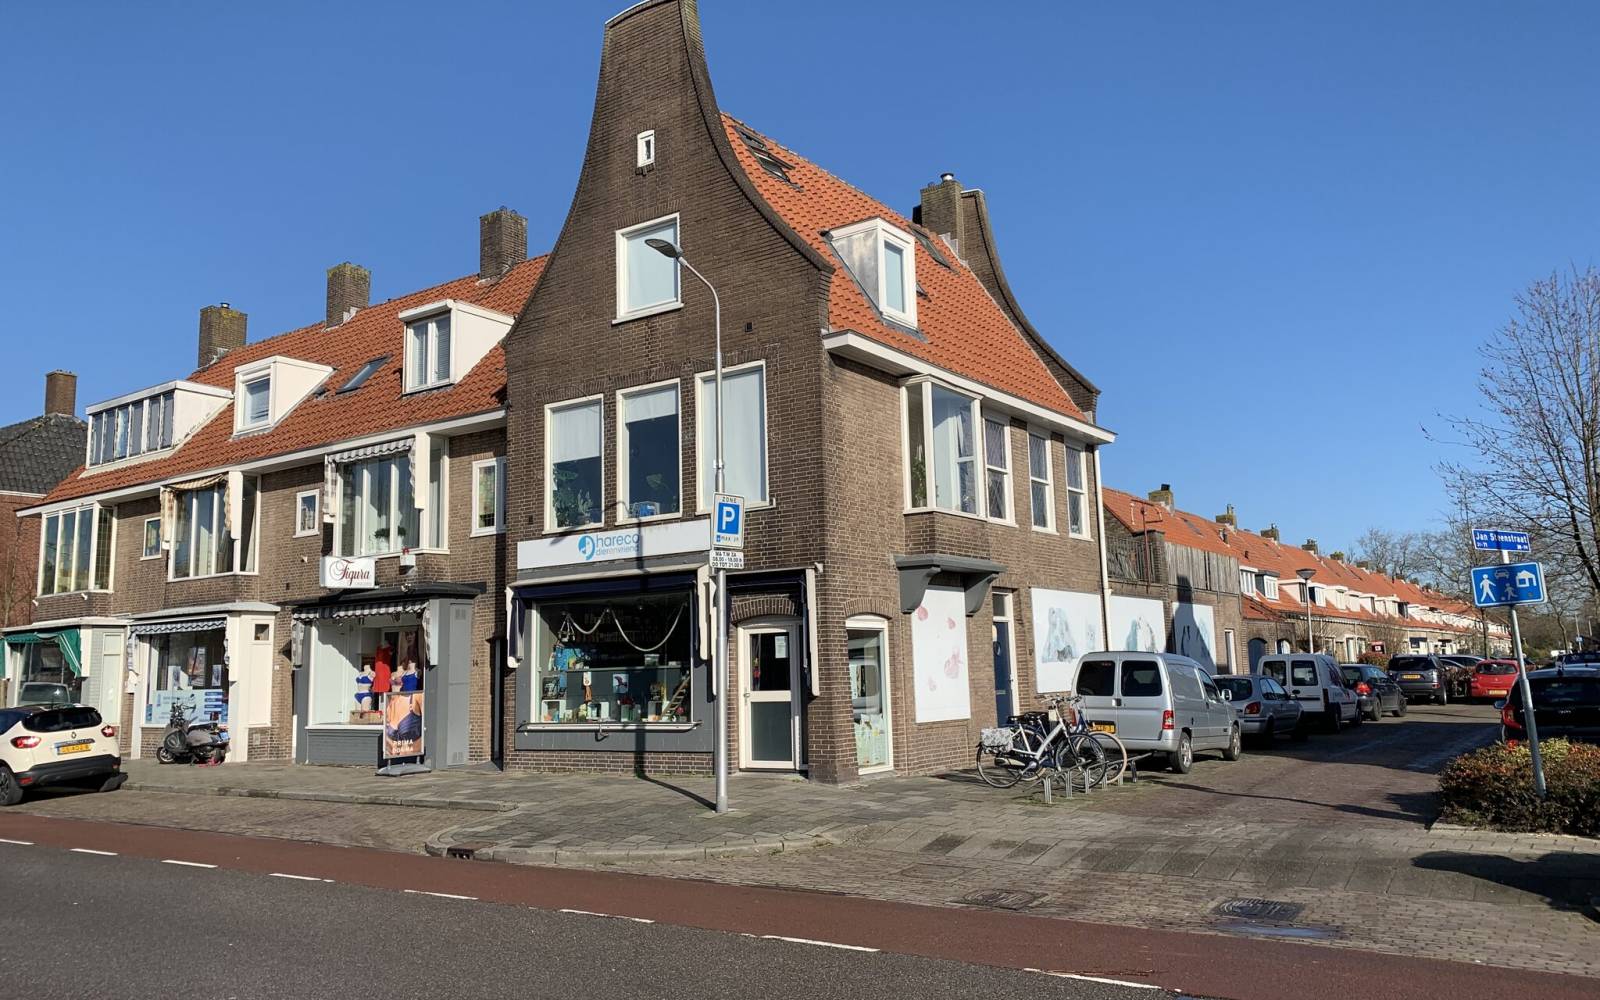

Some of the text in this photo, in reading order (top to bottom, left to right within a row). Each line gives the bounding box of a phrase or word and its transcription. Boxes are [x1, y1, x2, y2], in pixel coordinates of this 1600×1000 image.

[722, 506, 735, 530] P
[596, 533, 640, 548] hareco
[1476, 532, 1528, 543] Jan Steenstraat
[329, 559, 370, 586] Figura
